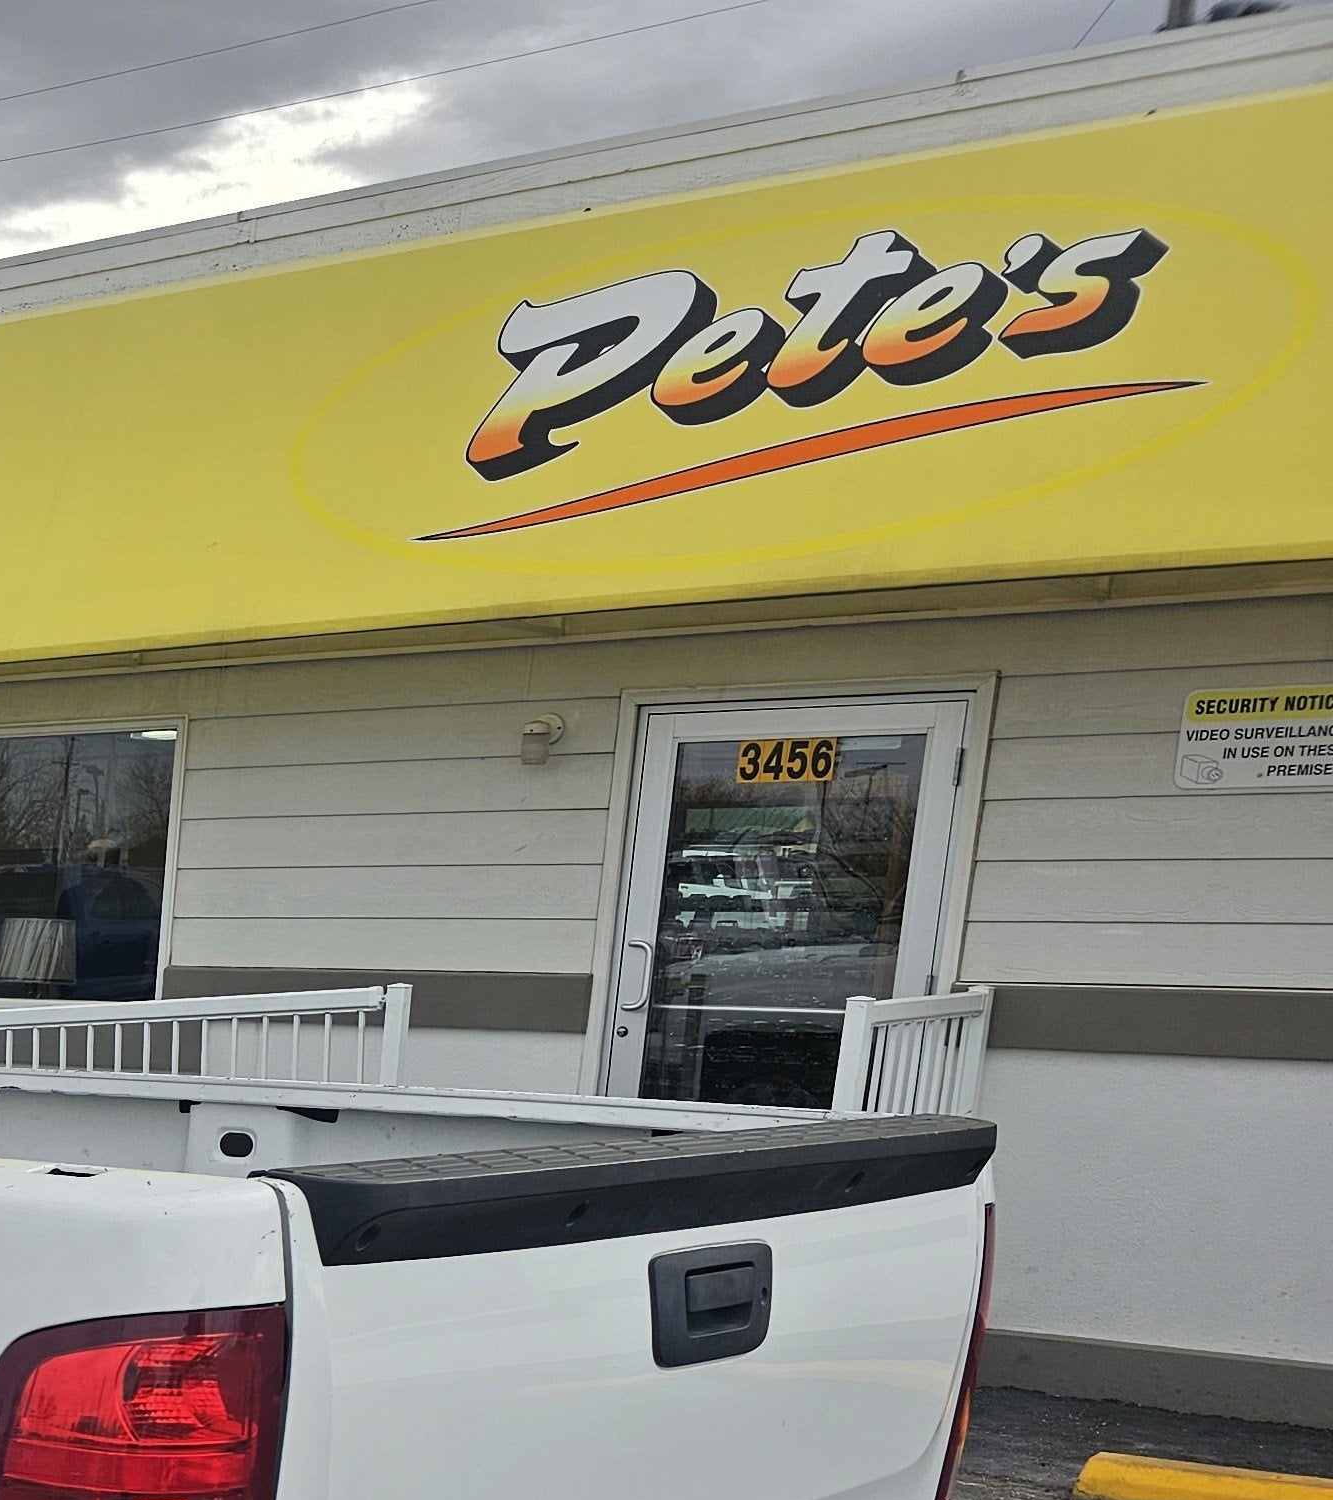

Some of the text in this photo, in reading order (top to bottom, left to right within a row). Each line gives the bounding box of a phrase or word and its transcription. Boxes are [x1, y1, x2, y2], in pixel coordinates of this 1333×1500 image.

[466, 227, 1169, 481] Pete's
[1195, 697, 1279, 715] SECURITY
[1186, 728, 1230, 742] VIDEO
[739, 739, 833, 780] 3456
[1223, 747, 1237, 759] IN
[1241, 746, 1270, 759] USE
[1274, 745, 1295, 758] ON
[1267, 764, 1333, 777] PREMISE
